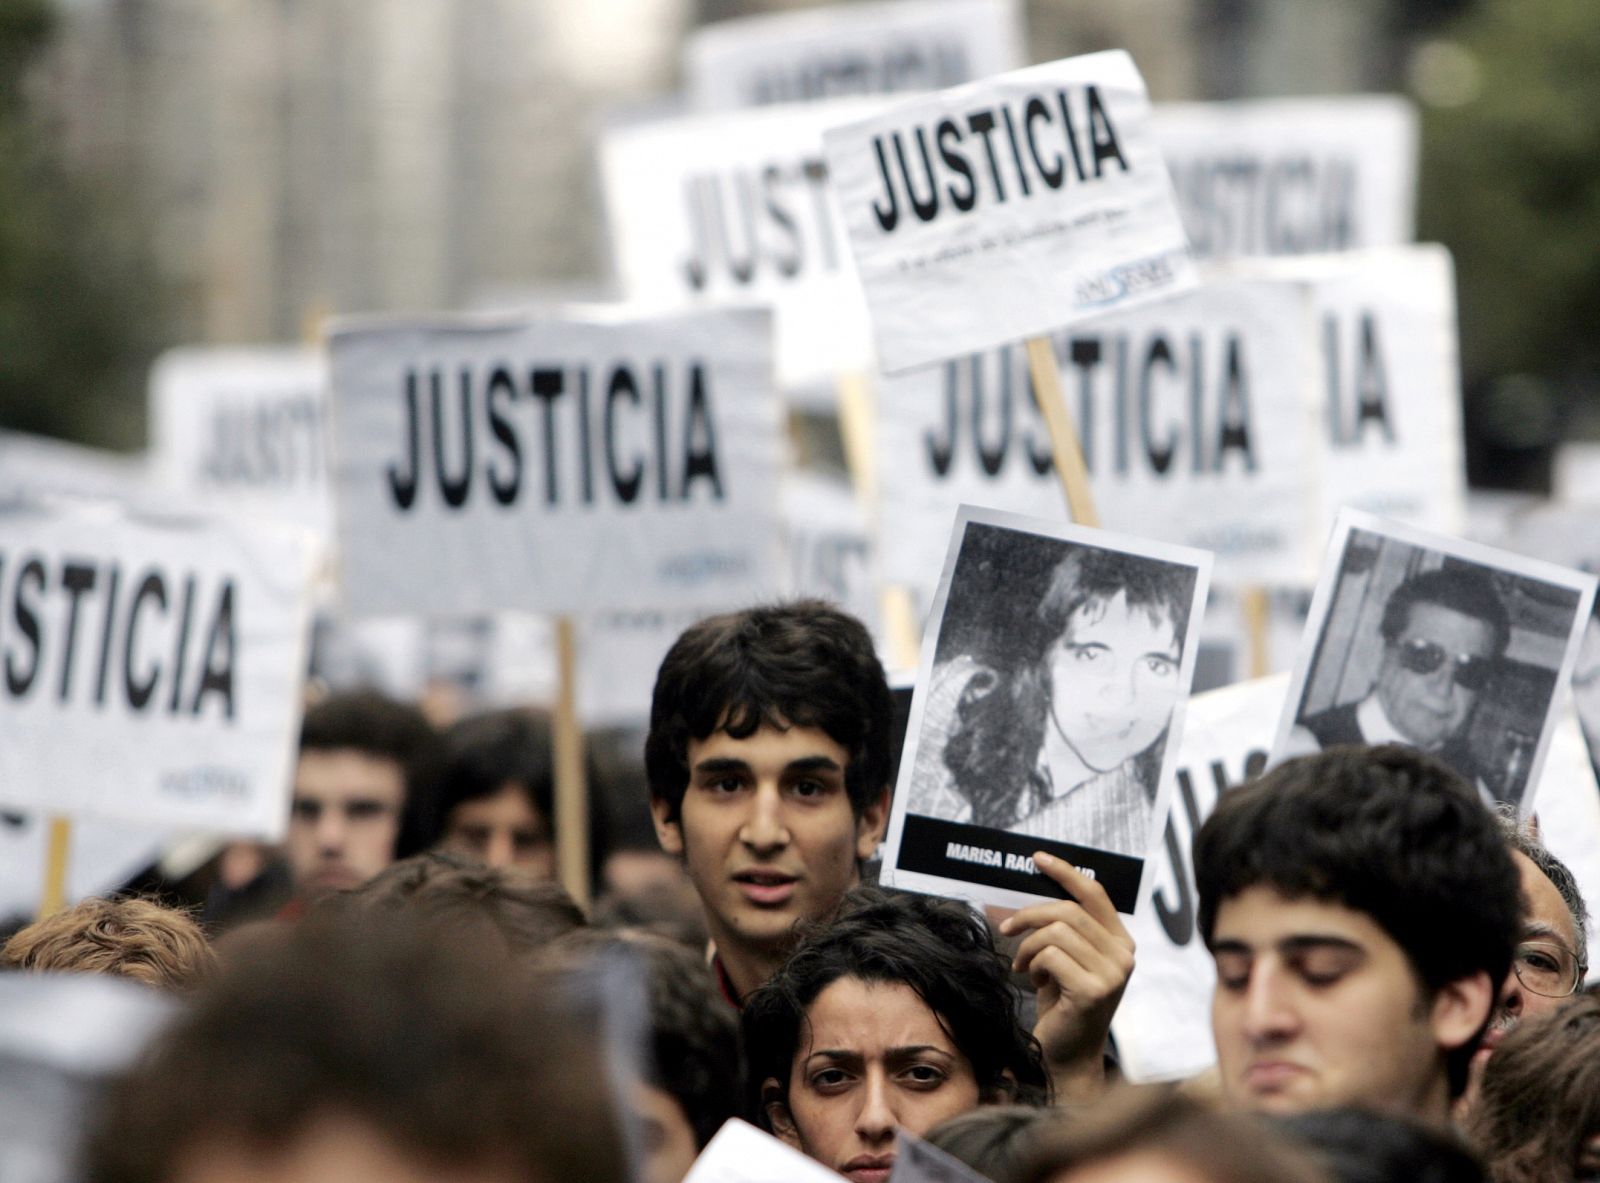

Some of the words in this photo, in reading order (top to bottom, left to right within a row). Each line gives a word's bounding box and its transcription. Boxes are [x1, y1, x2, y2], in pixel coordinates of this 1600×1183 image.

[870, 85, 1130, 232] JUSTICIA
[387, 363, 725, 510] JUSTICIA
[0, 556, 238, 721] STICIA
[946, 842, 1002, 867] MARISA
[1005, 853, 1042, 875] RAQ
